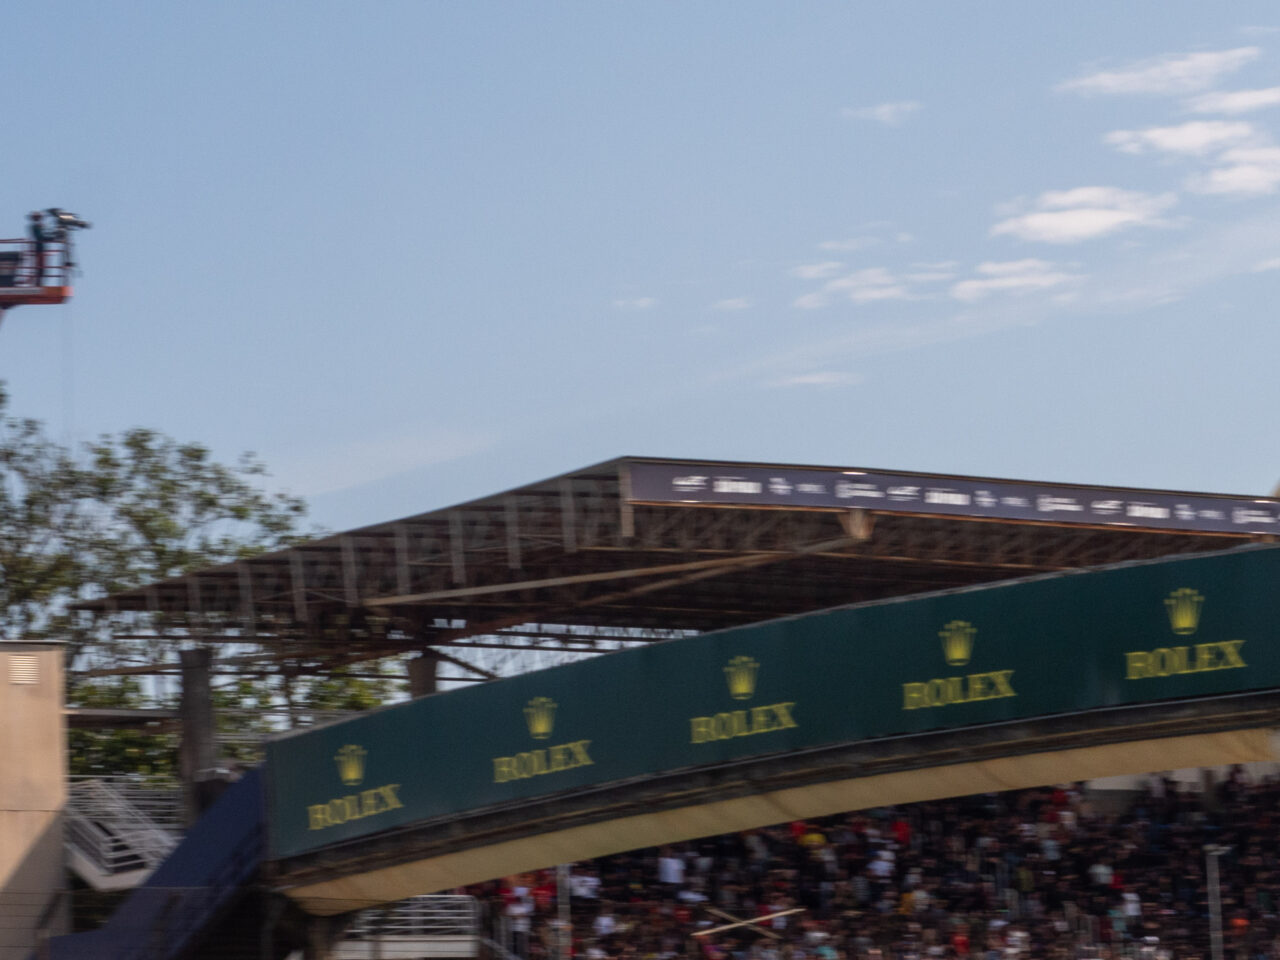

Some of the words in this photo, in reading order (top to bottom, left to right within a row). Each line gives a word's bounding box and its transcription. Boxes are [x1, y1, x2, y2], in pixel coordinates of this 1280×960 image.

[1126, 639, 1246, 680] ROLEX
[903, 669, 1017, 710] ROLEX
[690, 702, 798, 743] ROLEX
[493, 739, 594, 784] ROLEX
[307, 783, 403, 830] ROLEX
